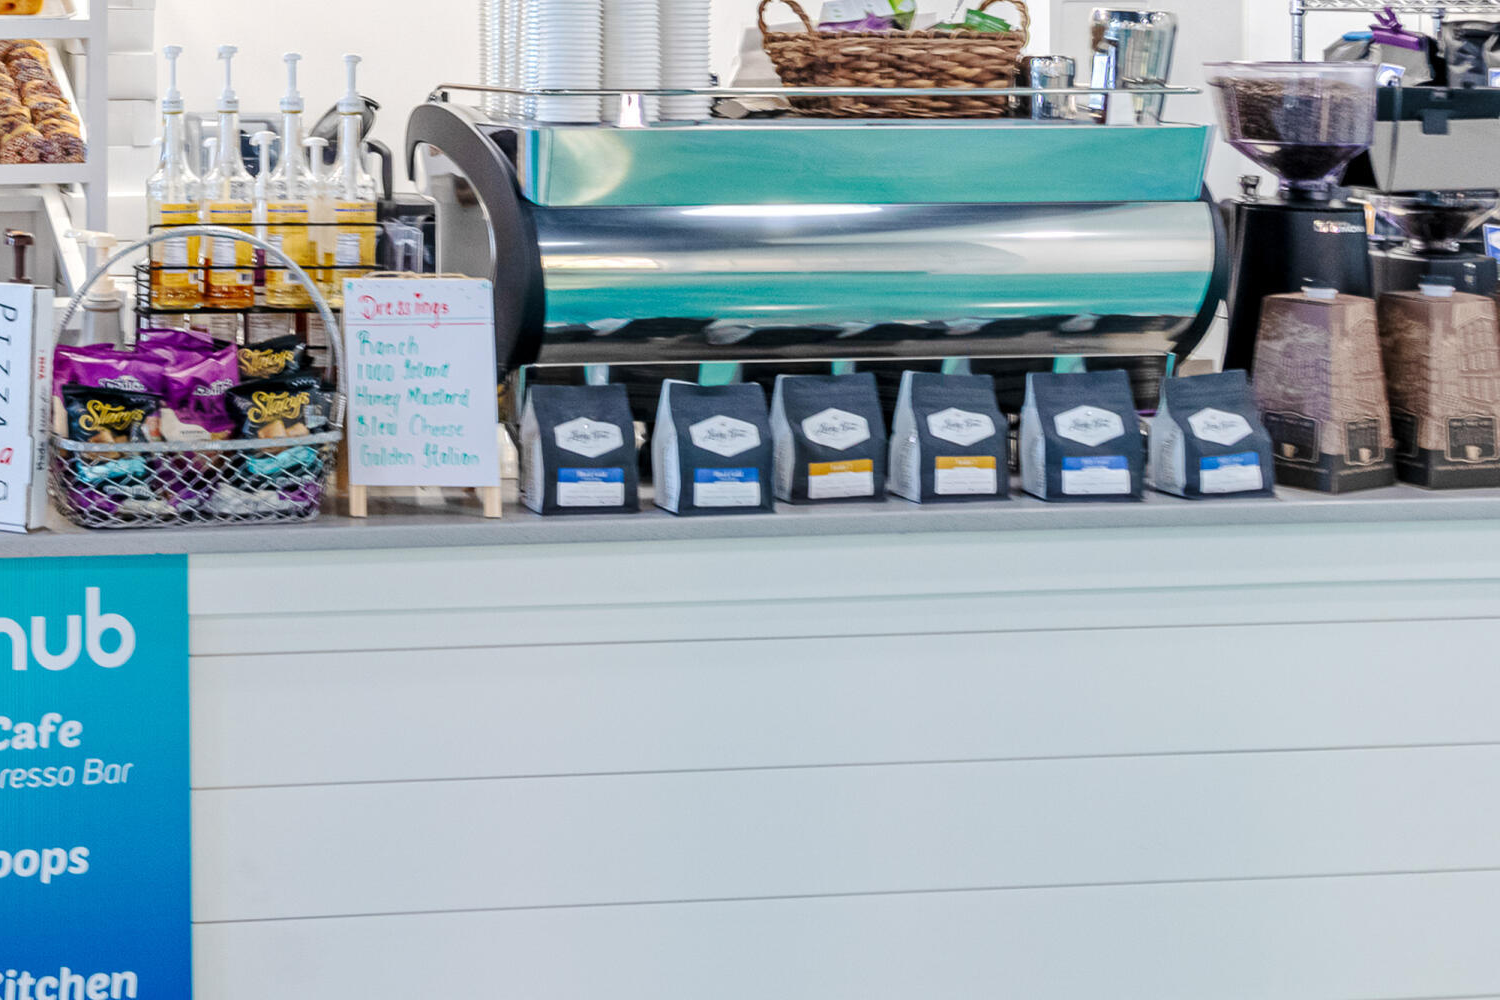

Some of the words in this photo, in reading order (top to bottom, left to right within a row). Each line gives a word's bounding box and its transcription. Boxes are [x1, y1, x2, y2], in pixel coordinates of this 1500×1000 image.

[358, 292, 450, 328] Dressings
[79, 399, 145, 432] Stacy's
[247, 391, 310, 423] Stacy's
[83, 758, 135, 785] Bar
